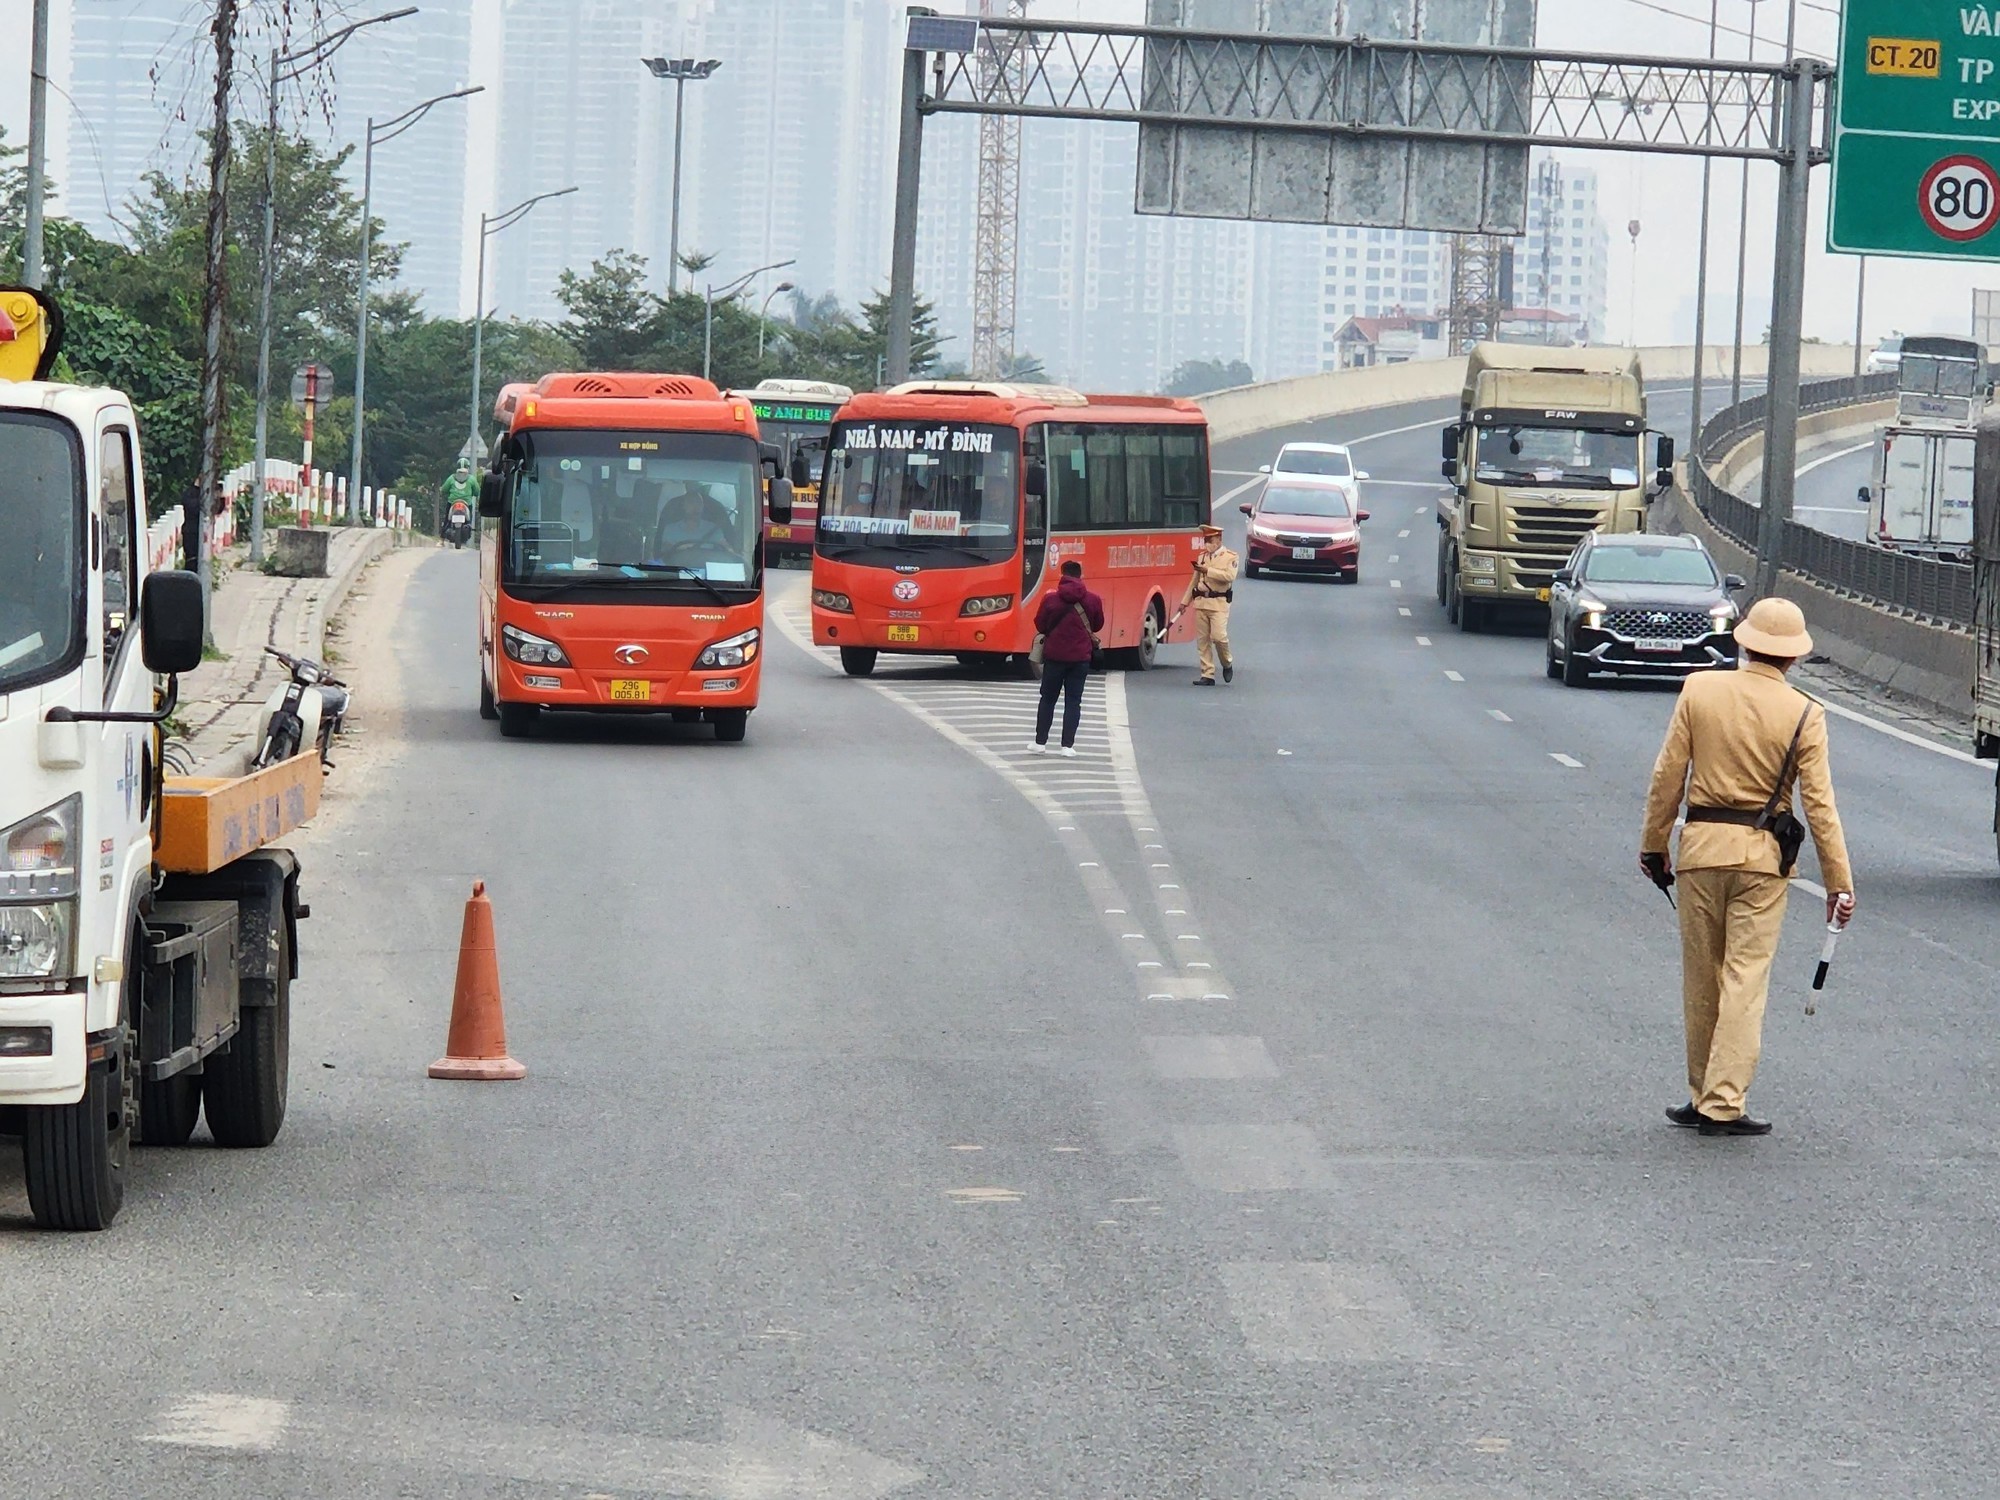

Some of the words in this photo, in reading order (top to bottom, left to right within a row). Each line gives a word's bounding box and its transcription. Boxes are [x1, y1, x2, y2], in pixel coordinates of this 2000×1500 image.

[1870, 45, 1938, 70] CT.20
[1957, 57, 1994, 84] TP
[1934, 176, 1989, 220] 80
[805, 408, 832, 421] BUS
[1544, 410, 1578, 419] FAW
[844, 424, 877, 449] NHÃ
[951, 426, 994, 454] ĐÌNH
[934, 515, 957, 532] NAM
[622, 681, 640, 690] 29G
[614, 690, 646, 700] 005.81
